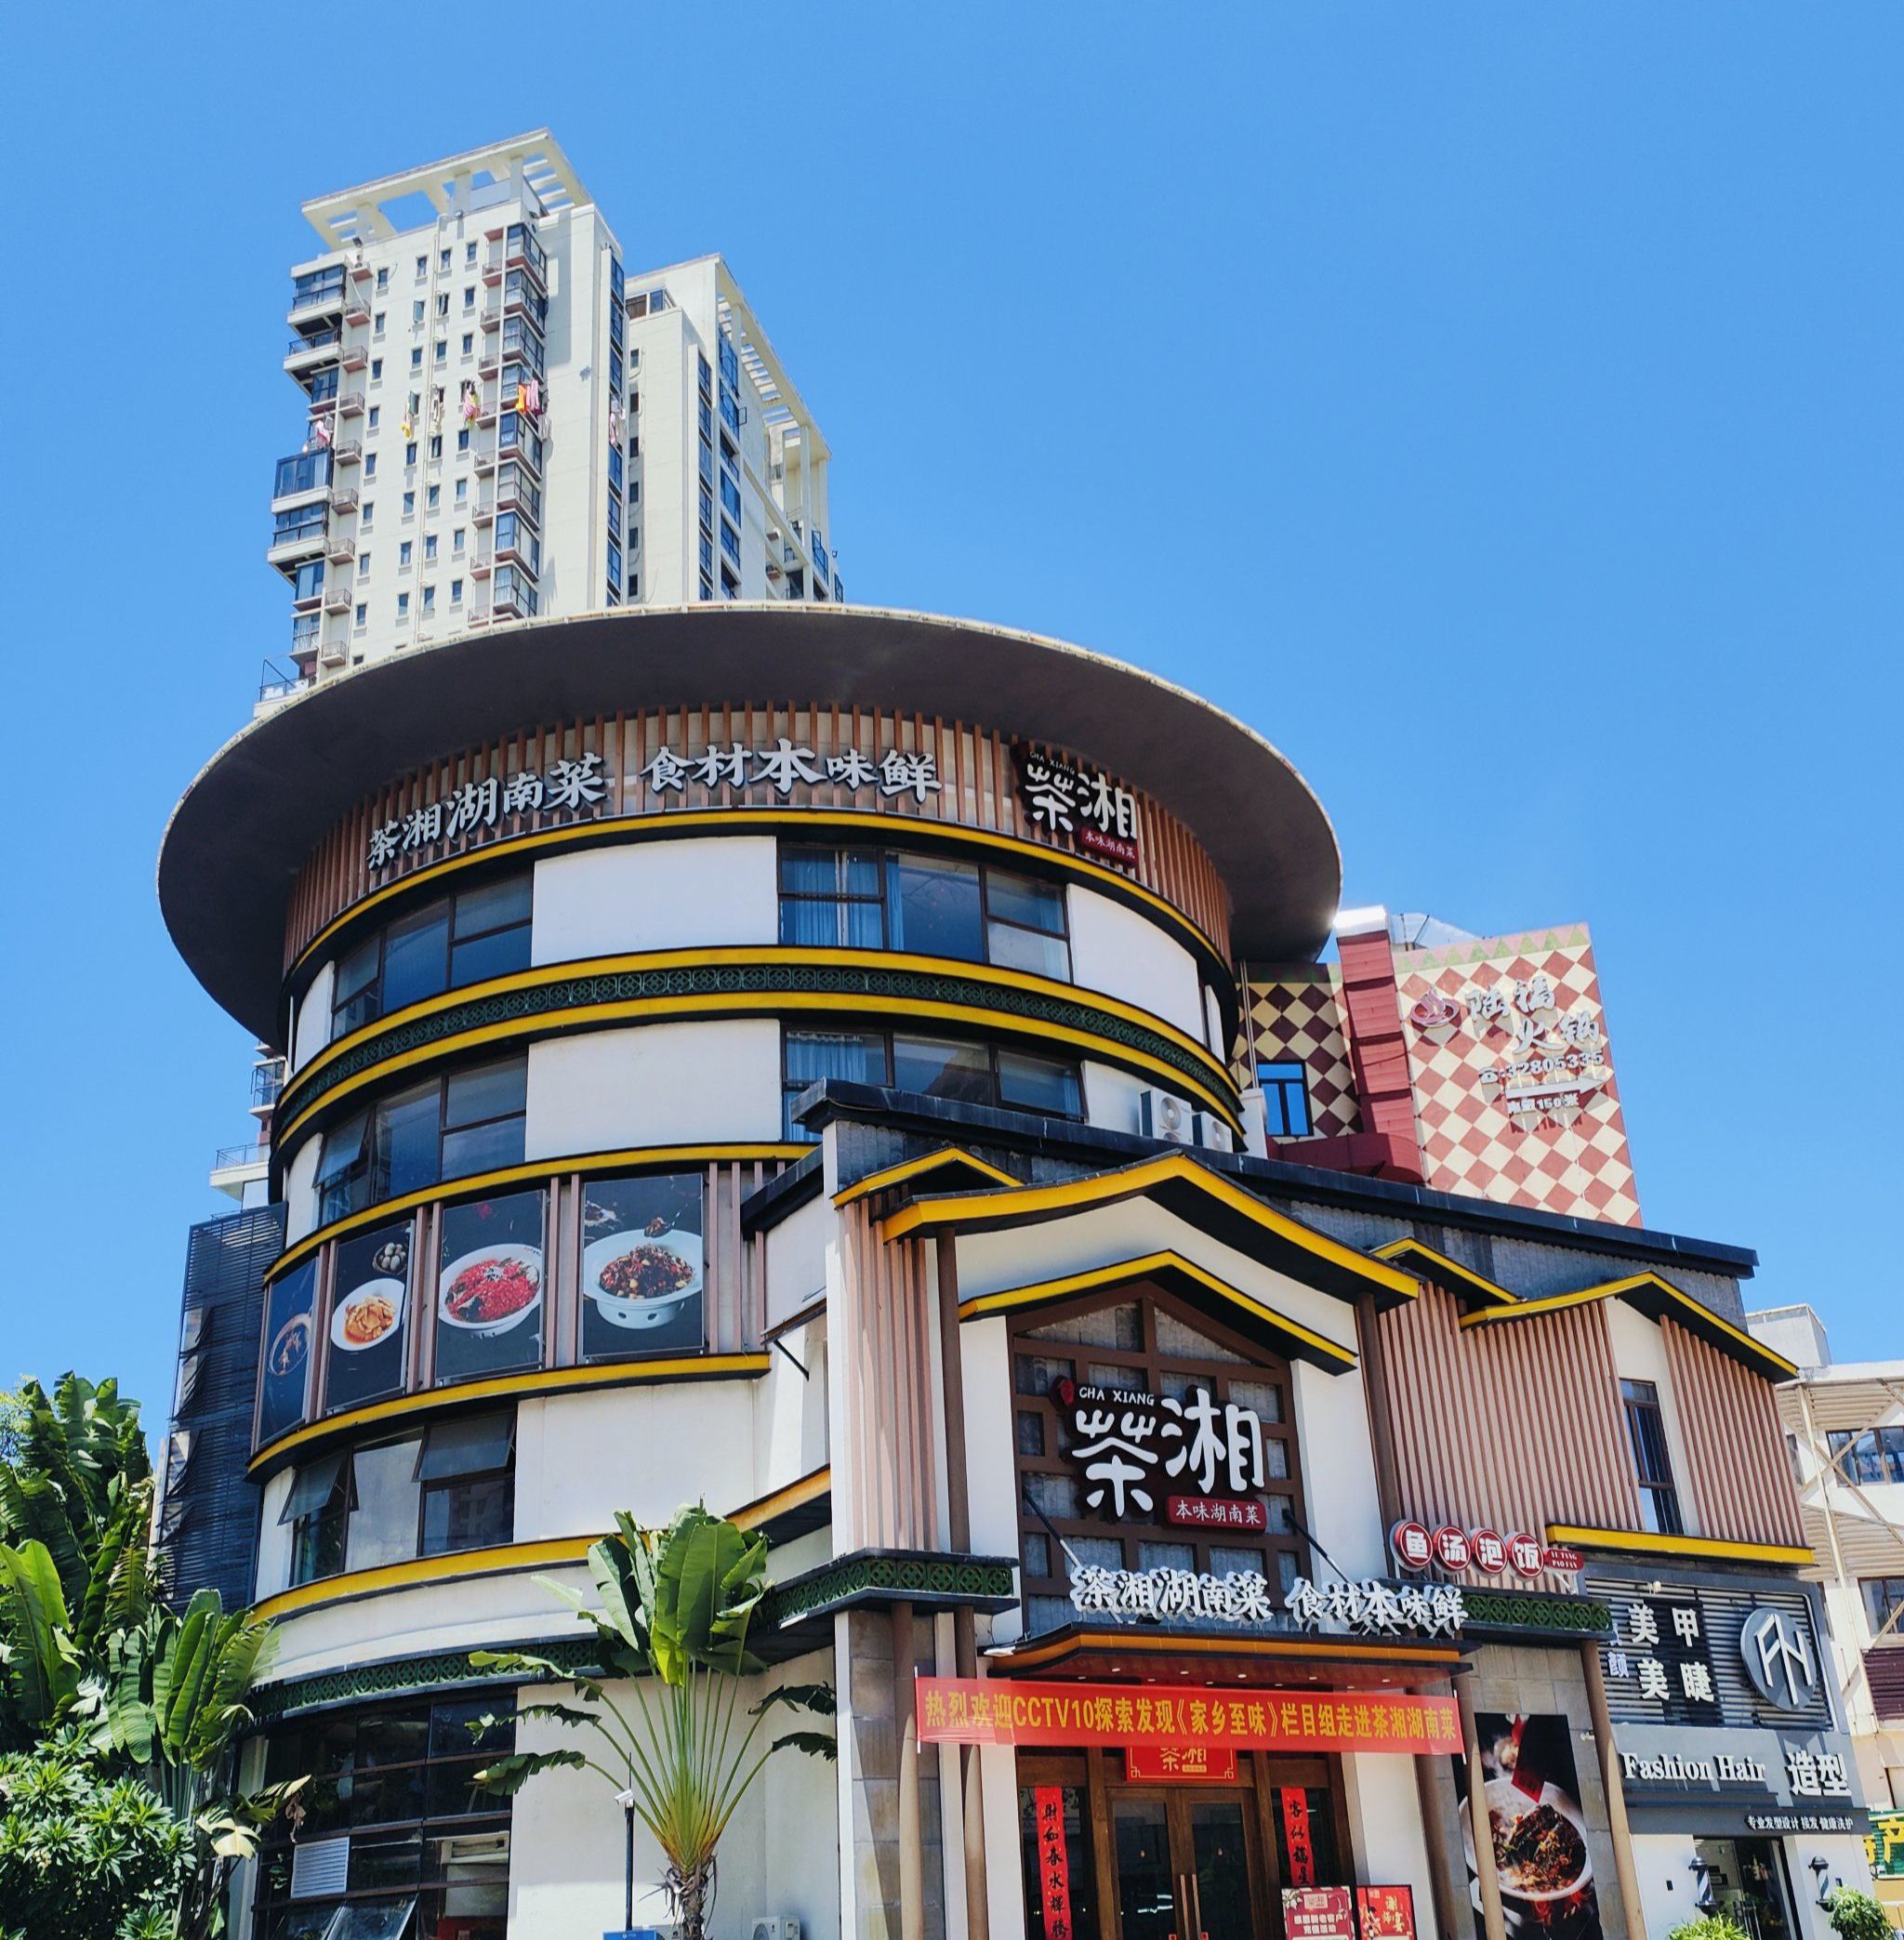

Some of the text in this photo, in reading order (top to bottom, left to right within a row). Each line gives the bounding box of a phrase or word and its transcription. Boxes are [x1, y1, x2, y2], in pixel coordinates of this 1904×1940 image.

[640, 737, 943, 806] 食材本味鲜
[1029, 750, 1076, 775] CHA XIANG
[365, 751, 609, 870] 茶湘湖南菜
[1085, 830, 1136, 860] 本味湖南菜
[1078, 1386, 1156, 1406] CHA XIANG
[1071, 1387, 1265, 1518] 茶湘
[1175, 1498, 1263, 1525] 本味湖南菜
[1406, 1530, 1540, 1570] 鱼汤泡饭
[1075, 1567, 1273, 1622] 茶湘湖南菜
[1292, 1578, 1469, 1630] 食材本味鲜
[1628, 1603, 1699, 1647] 美甲
[1637, 1657, 1714, 1702] 美睫
[924, 1689, 1457, 1741] 热烈欢迎CCTV10探索发现《家乡至味》栏目组走进茶湘湖南菜
[1621, 1749, 1853, 1798] Fashion Hair 造型
[1746, 1815, 1854, 1831] 专业发型设计 接发 健康洗护
